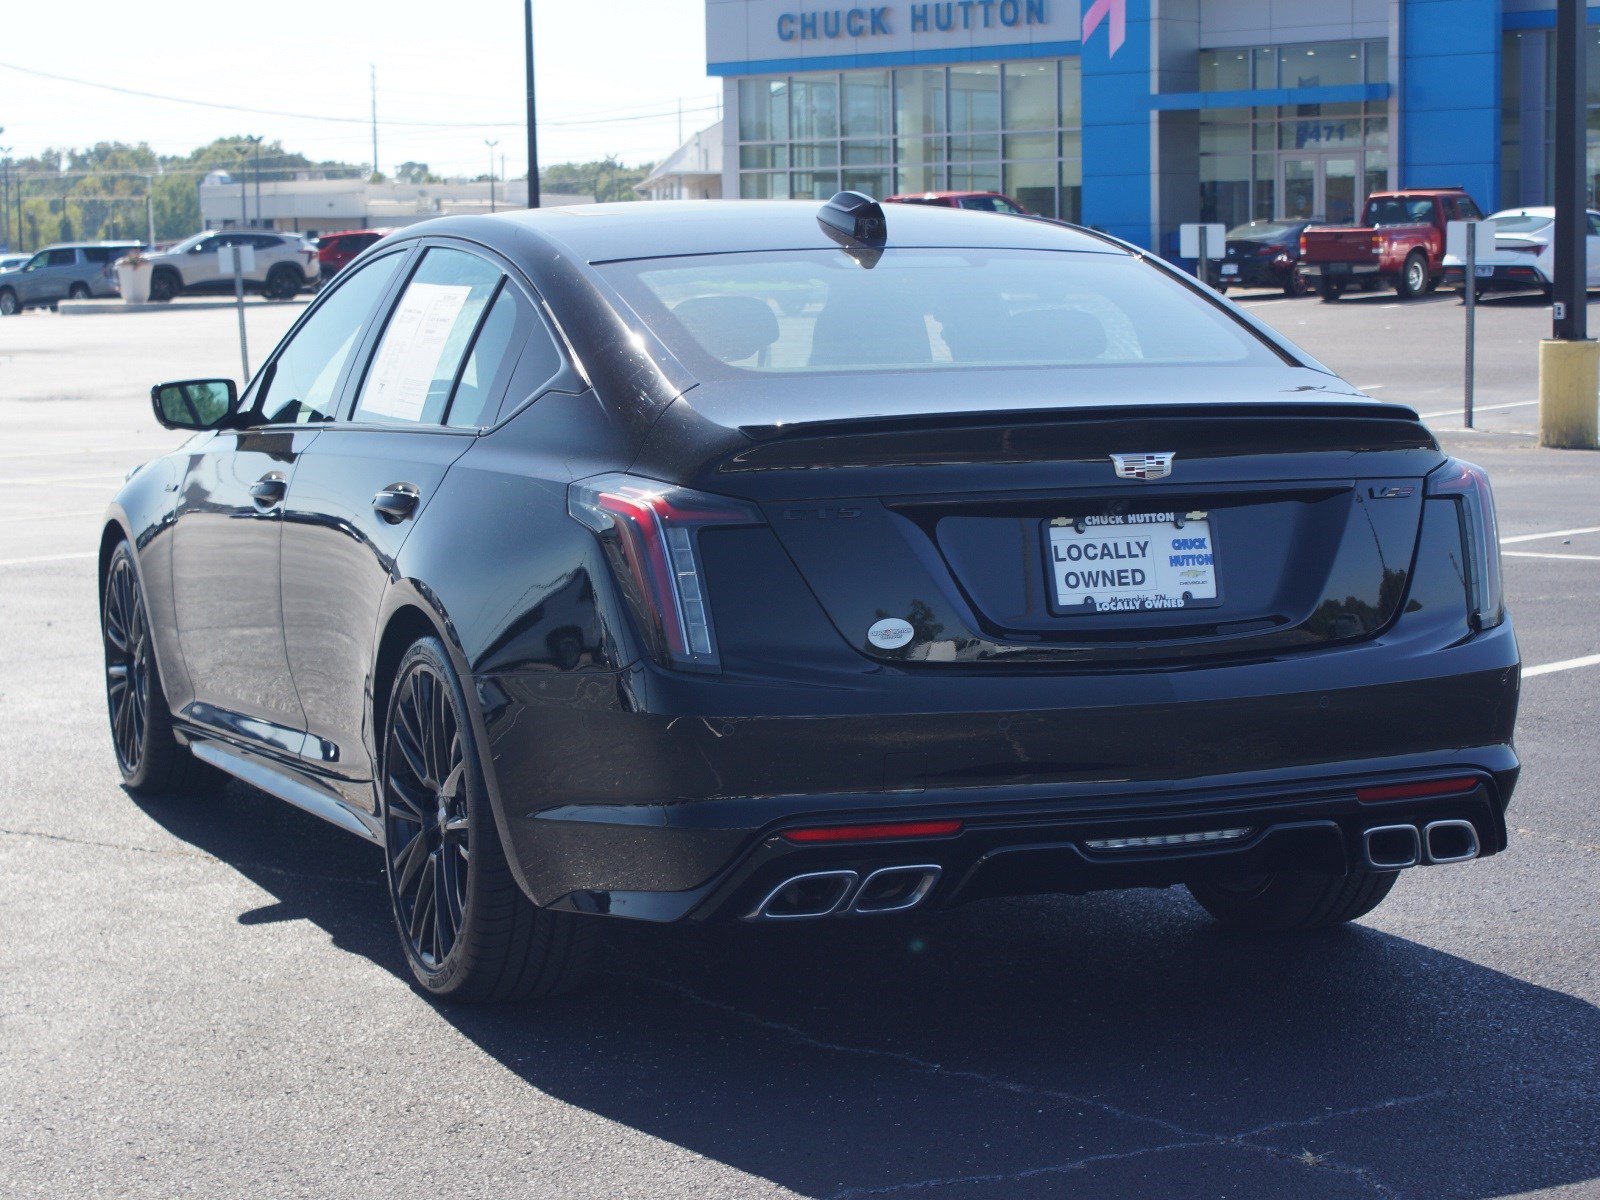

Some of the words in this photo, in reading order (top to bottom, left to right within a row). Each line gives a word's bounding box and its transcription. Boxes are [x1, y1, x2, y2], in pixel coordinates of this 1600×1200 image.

[777, 7, 889, 42] CHUCK
[911, 0, 1045, 32] HUTTON
[1084, 515, 1123, 526] CHUCK
[1128, 512, 1175, 525] HUTTON
[1053, 540, 1149, 562] LOCALLY
[1172, 538, 1207, 550] CHUCK
[1169, 553, 1214, 567] HUTTON
[1064, 568, 1146, 589] OWNED
[1096, 600, 1140, 612] LOCALLY
[1145, 599, 1185, 610] OWNED
